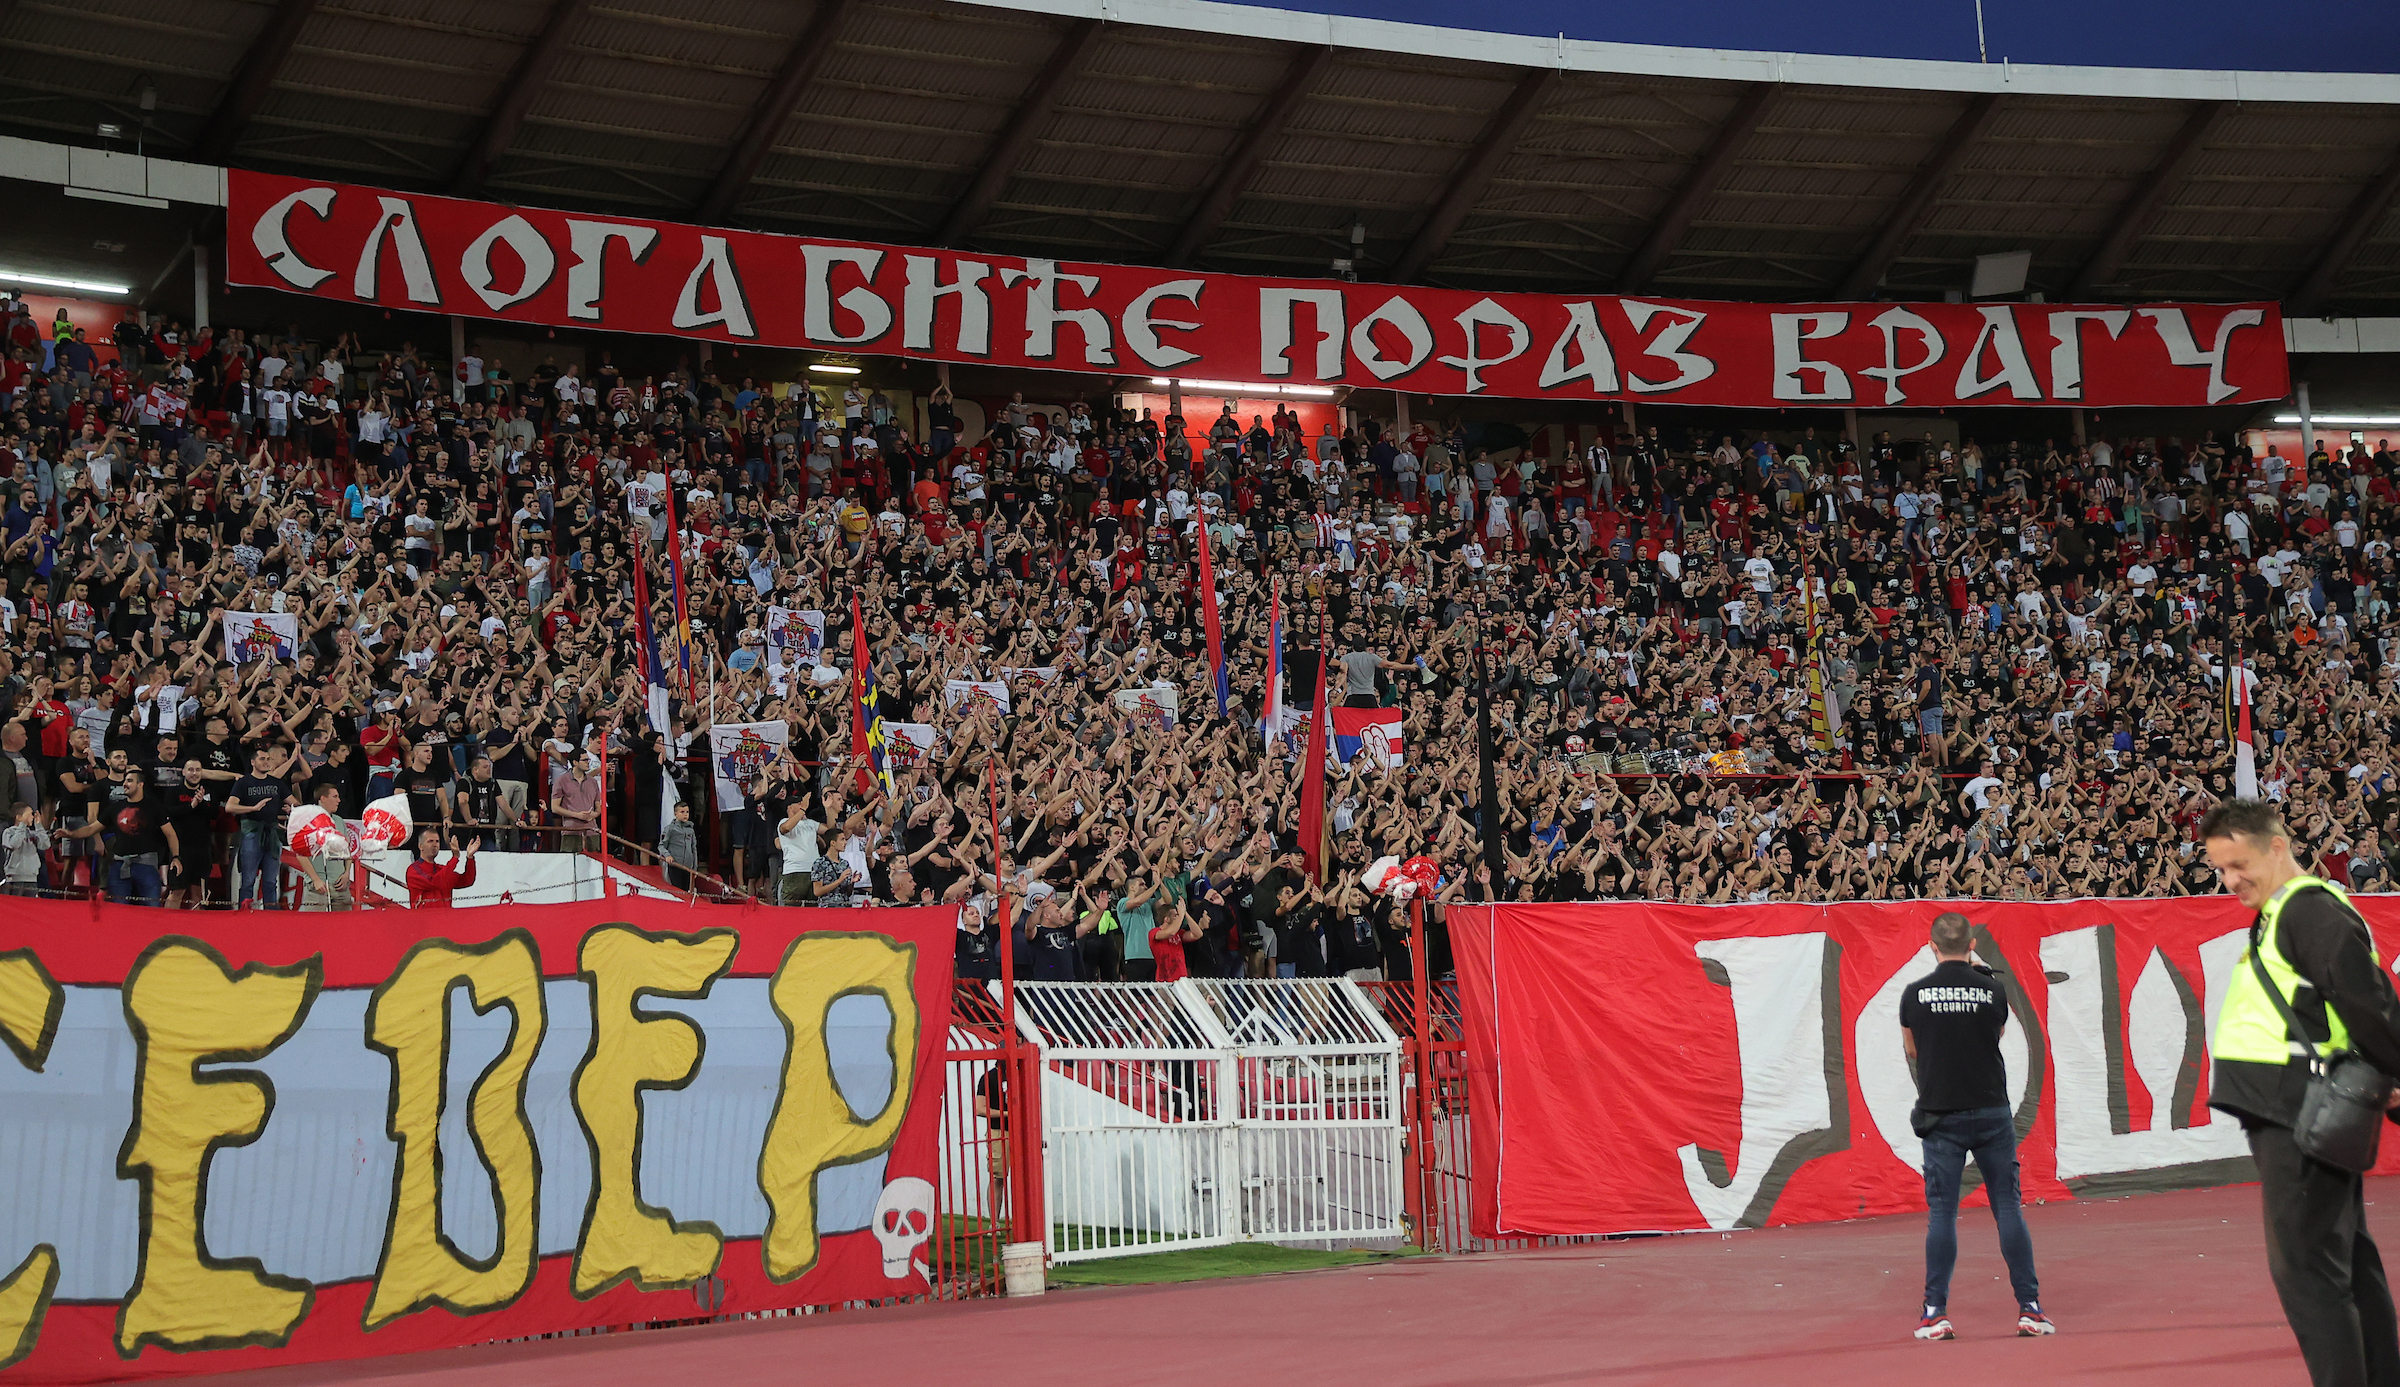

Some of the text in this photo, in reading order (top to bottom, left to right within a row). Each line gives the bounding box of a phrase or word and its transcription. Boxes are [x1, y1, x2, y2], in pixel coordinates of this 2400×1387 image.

[251, 186, 2265, 406] СЛОГА БИЋЕ ПОРАЗ ВРАГУ
[1917, 986, 1994, 1005] ОБЕЗБЕЂЕЊЕ
[1930, 1002, 1979, 1013] SECURITY
